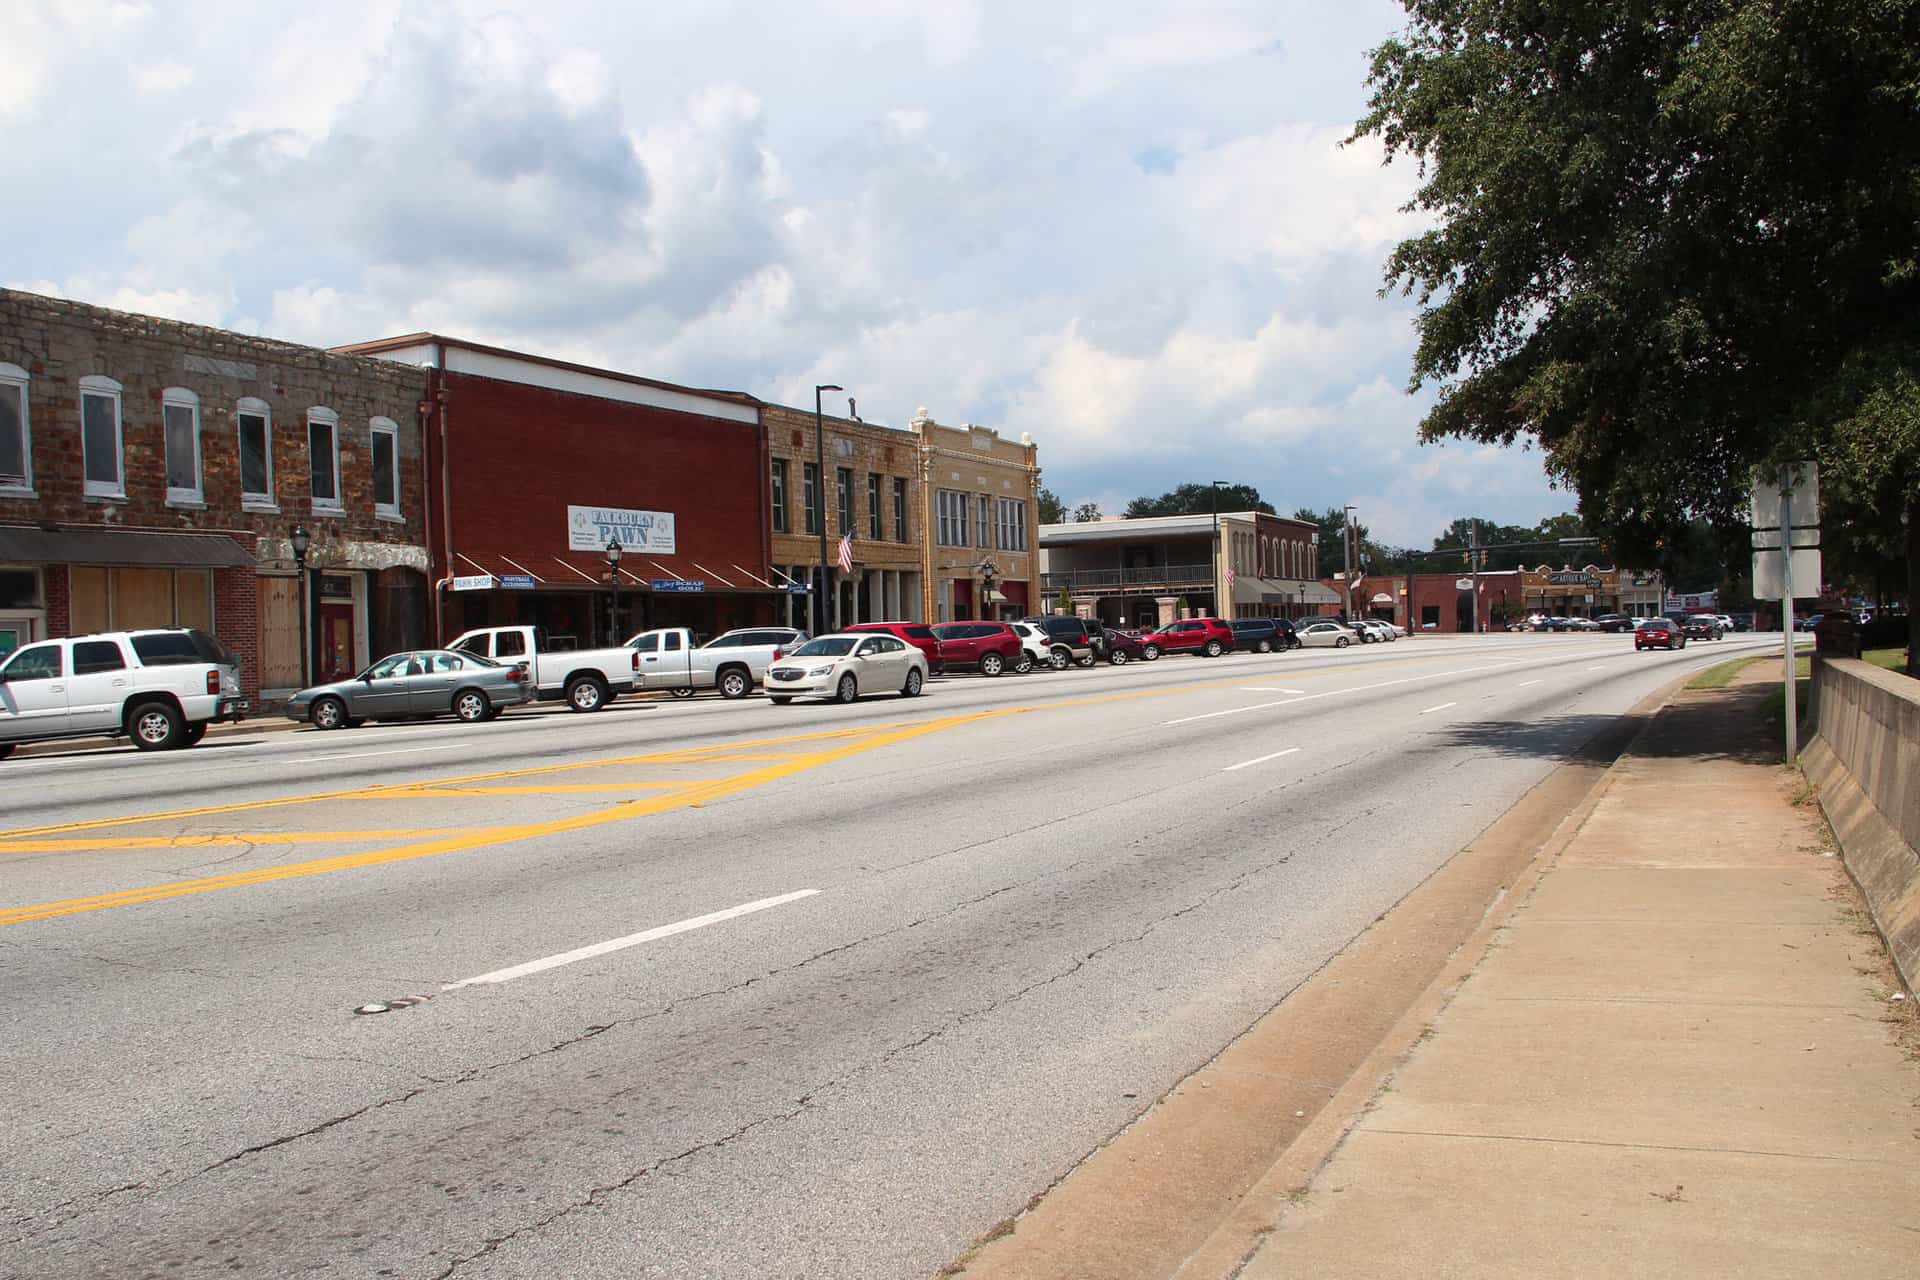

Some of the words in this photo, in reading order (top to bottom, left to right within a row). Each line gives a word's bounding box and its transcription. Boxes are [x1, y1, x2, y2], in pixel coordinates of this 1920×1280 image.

[591, 510, 655, 528] FAIRBURN
[599, 526, 648, 545] PAWN
[473, 577, 491, 587] SHOP
